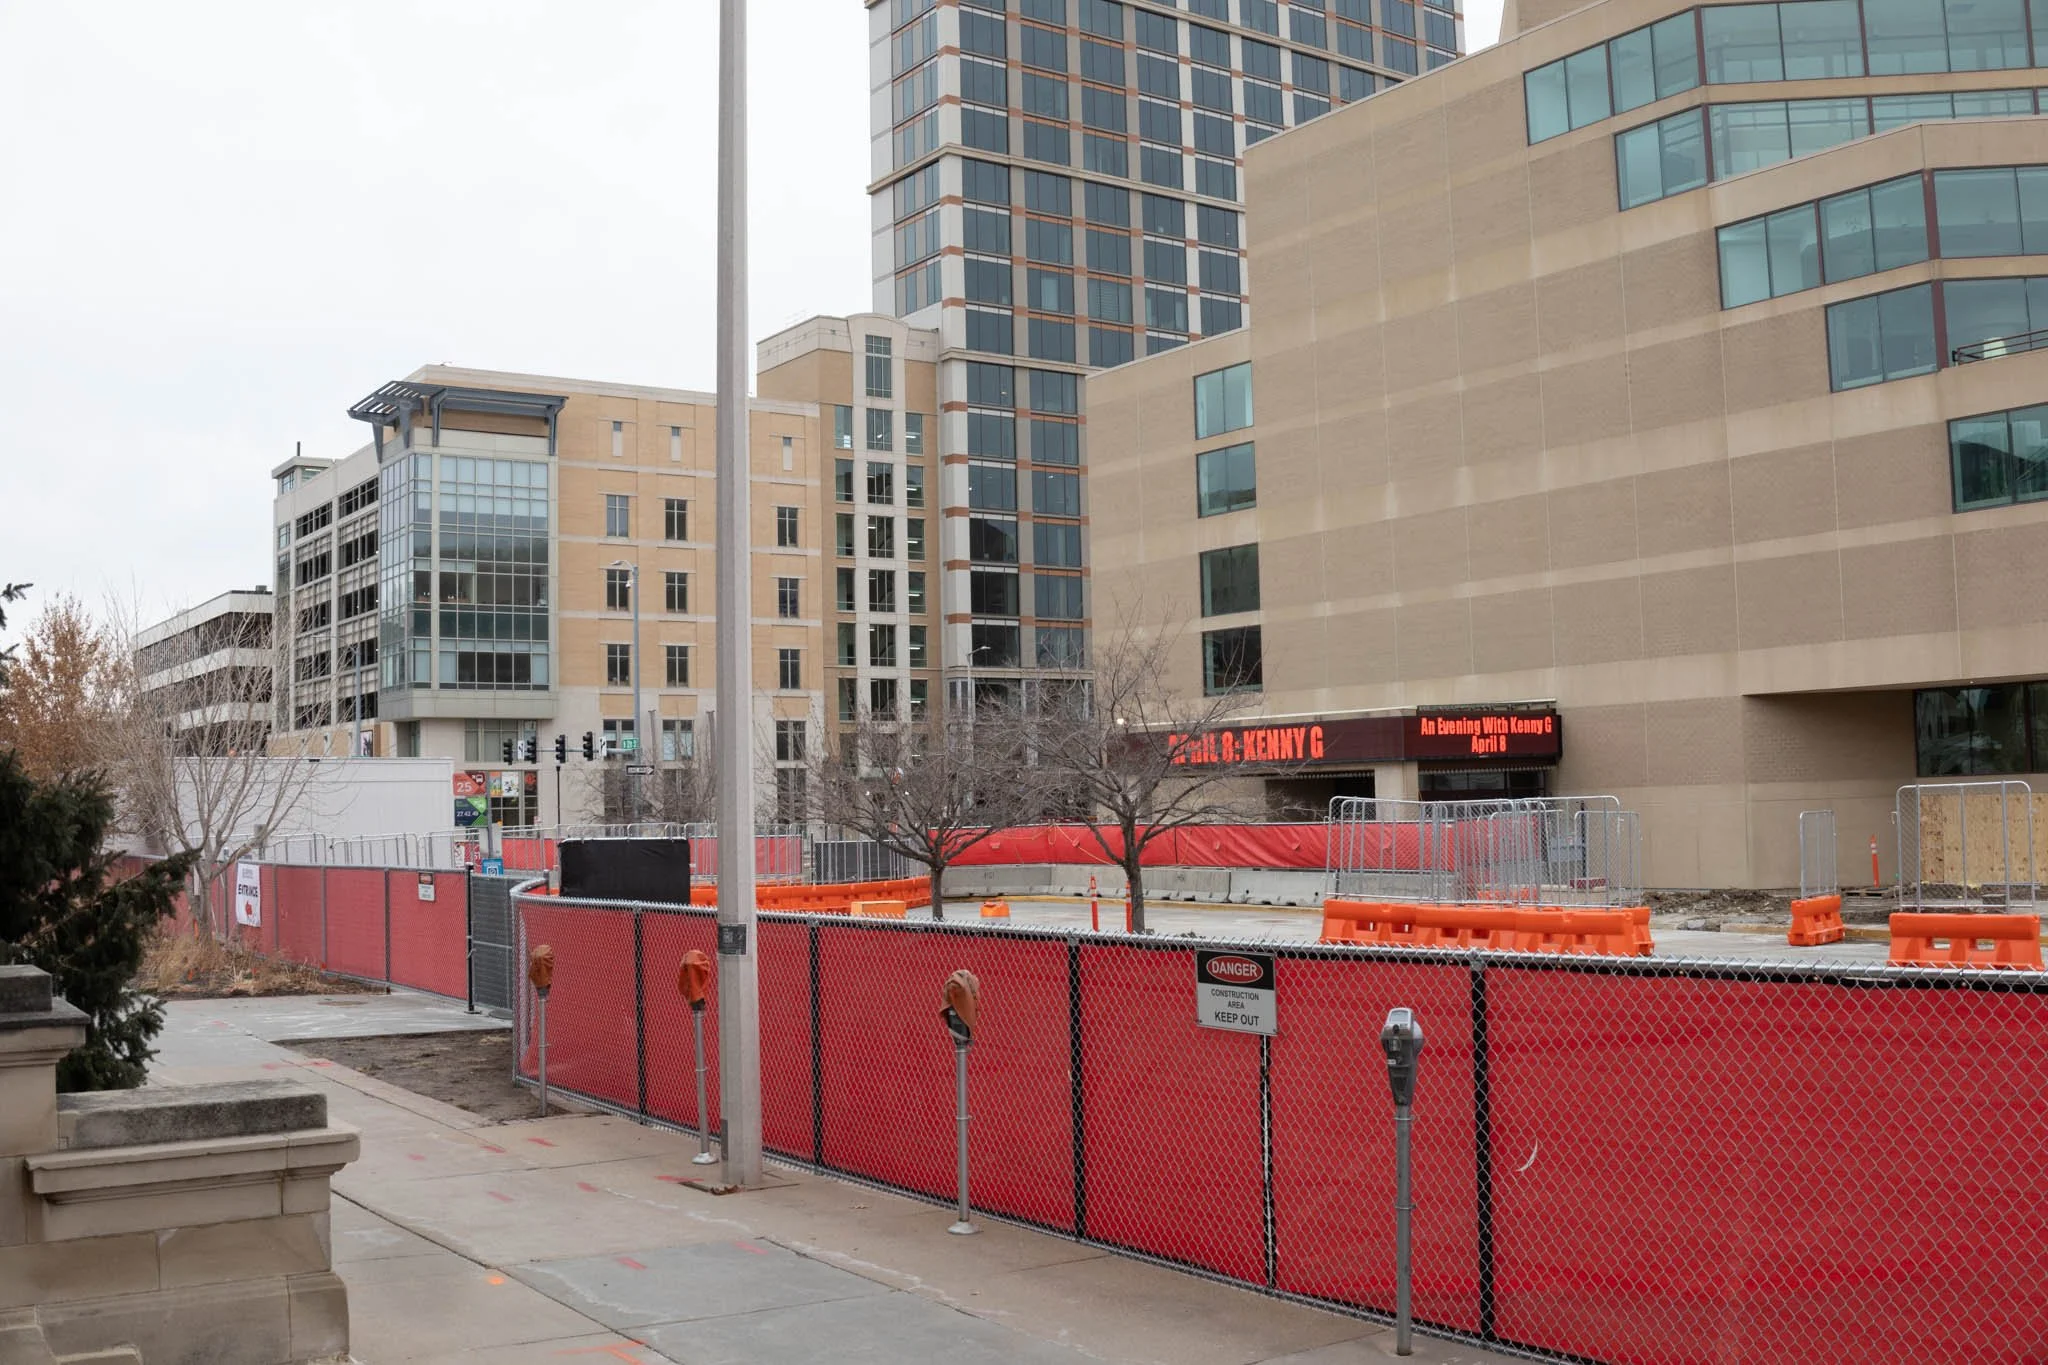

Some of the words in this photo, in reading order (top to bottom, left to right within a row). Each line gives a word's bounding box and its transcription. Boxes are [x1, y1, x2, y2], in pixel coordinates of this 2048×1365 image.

[1421, 717, 1435, 735] An
[1437, 717, 1481, 735] Evening
[1482, 716, 1508, 734] With
[1510, 716, 1543, 734] Kenny
[1544, 716, 1552, 733] G
[1222, 731, 1241, 764] 8:
[1243, 728, 1306, 761] KENNY
[1310, 725, 1324, 759] G
[1471, 735, 1498, 754] April
[1499, 735, 1507, 752] 8
[456, 782, 472, 793] 25
[1212, 961, 1257, 977] DANGER
[1211, 989, 1259, 1000] CONSTRUCTION
[1227, 1001, 1245, 1010] AREA
[1214, 1011, 1238, 1024] KEEP
[1240, 1014, 1260, 1027] OUT
